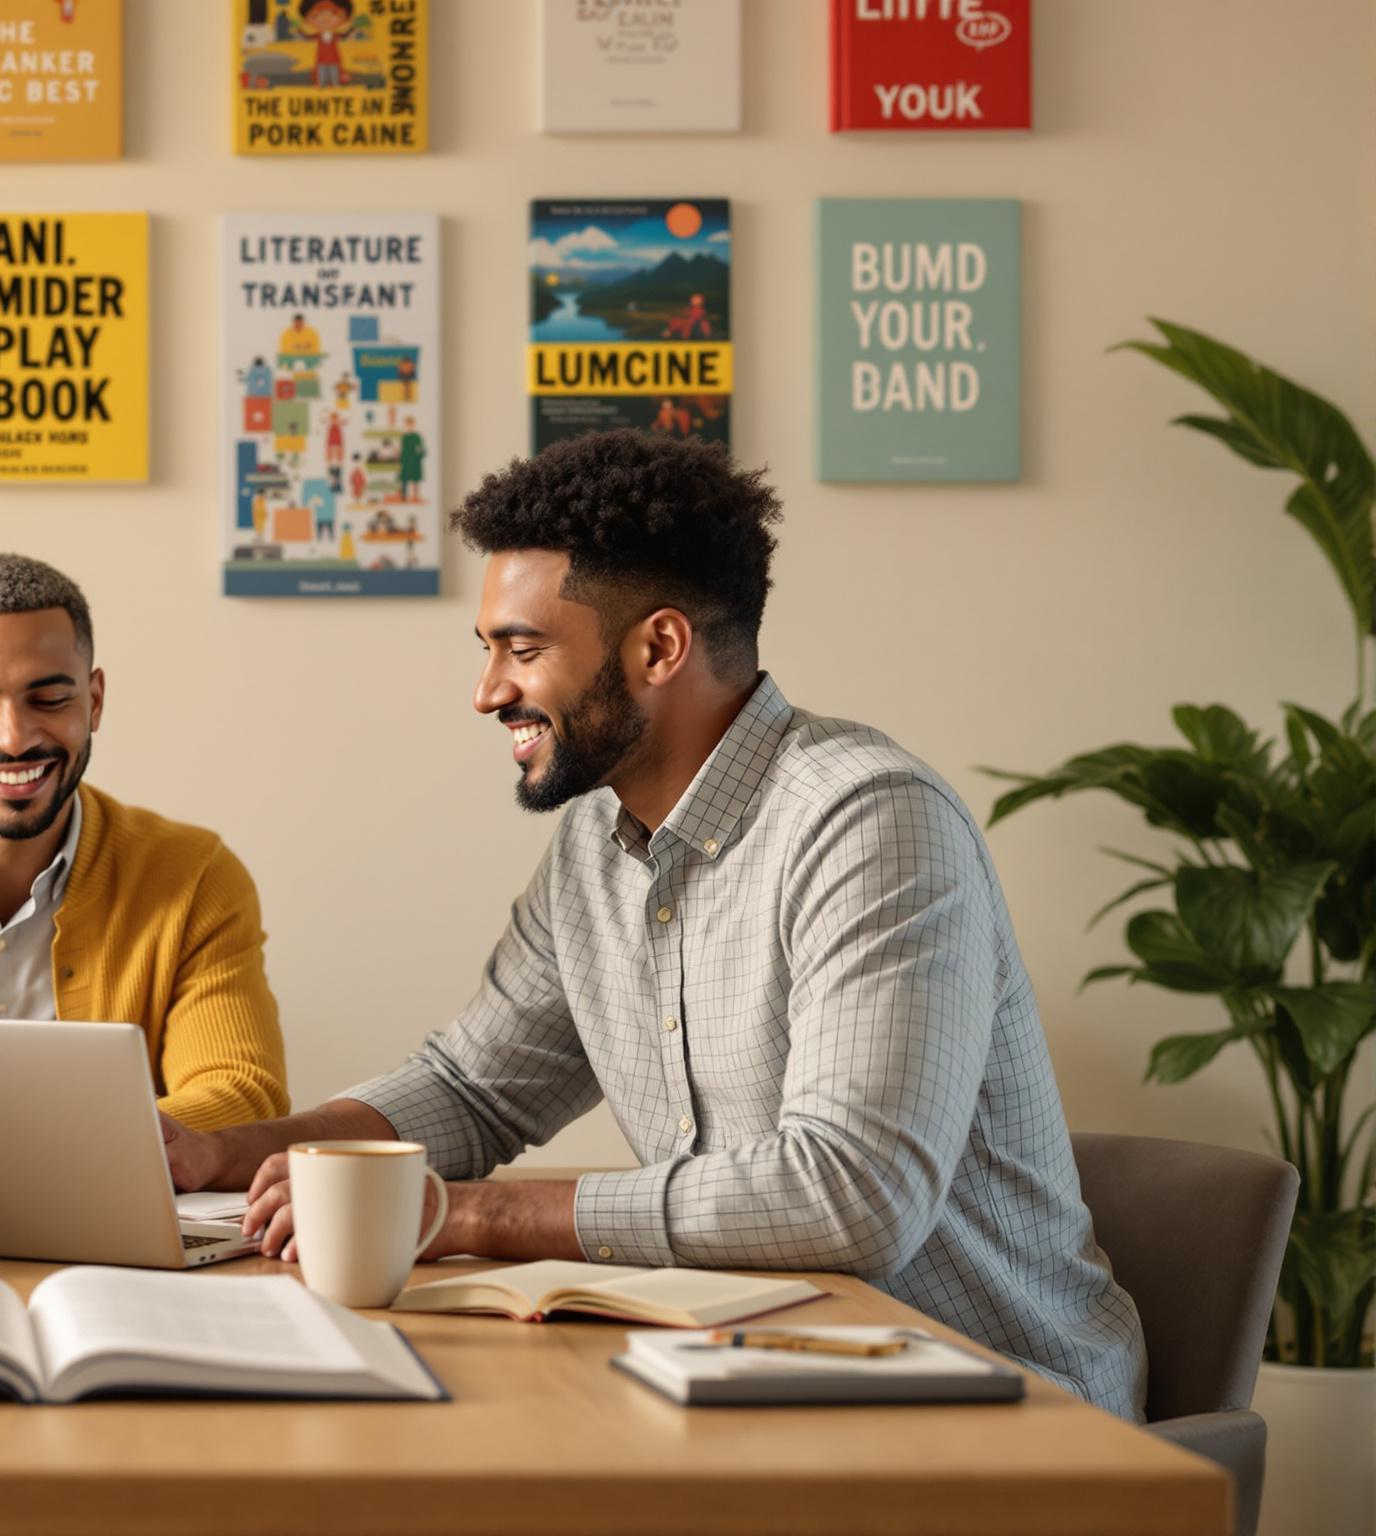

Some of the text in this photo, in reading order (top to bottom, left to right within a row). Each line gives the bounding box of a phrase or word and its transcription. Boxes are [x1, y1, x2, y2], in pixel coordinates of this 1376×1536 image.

[26, 79, 100, 104] BEST
[873, 83, 982, 119] YOUK
[245, 96, 281, 117] THE
[249, 122, 415, 146] PORK CAINE
[239, 236, 422, 264] LITERATURE
[851, 243, 987, 293] BUMD
[242, 283, 415, 309] TRANSFANT
[535, 352, 720, 386] LUMCINE
[851, 361, 980, 412] BAND
